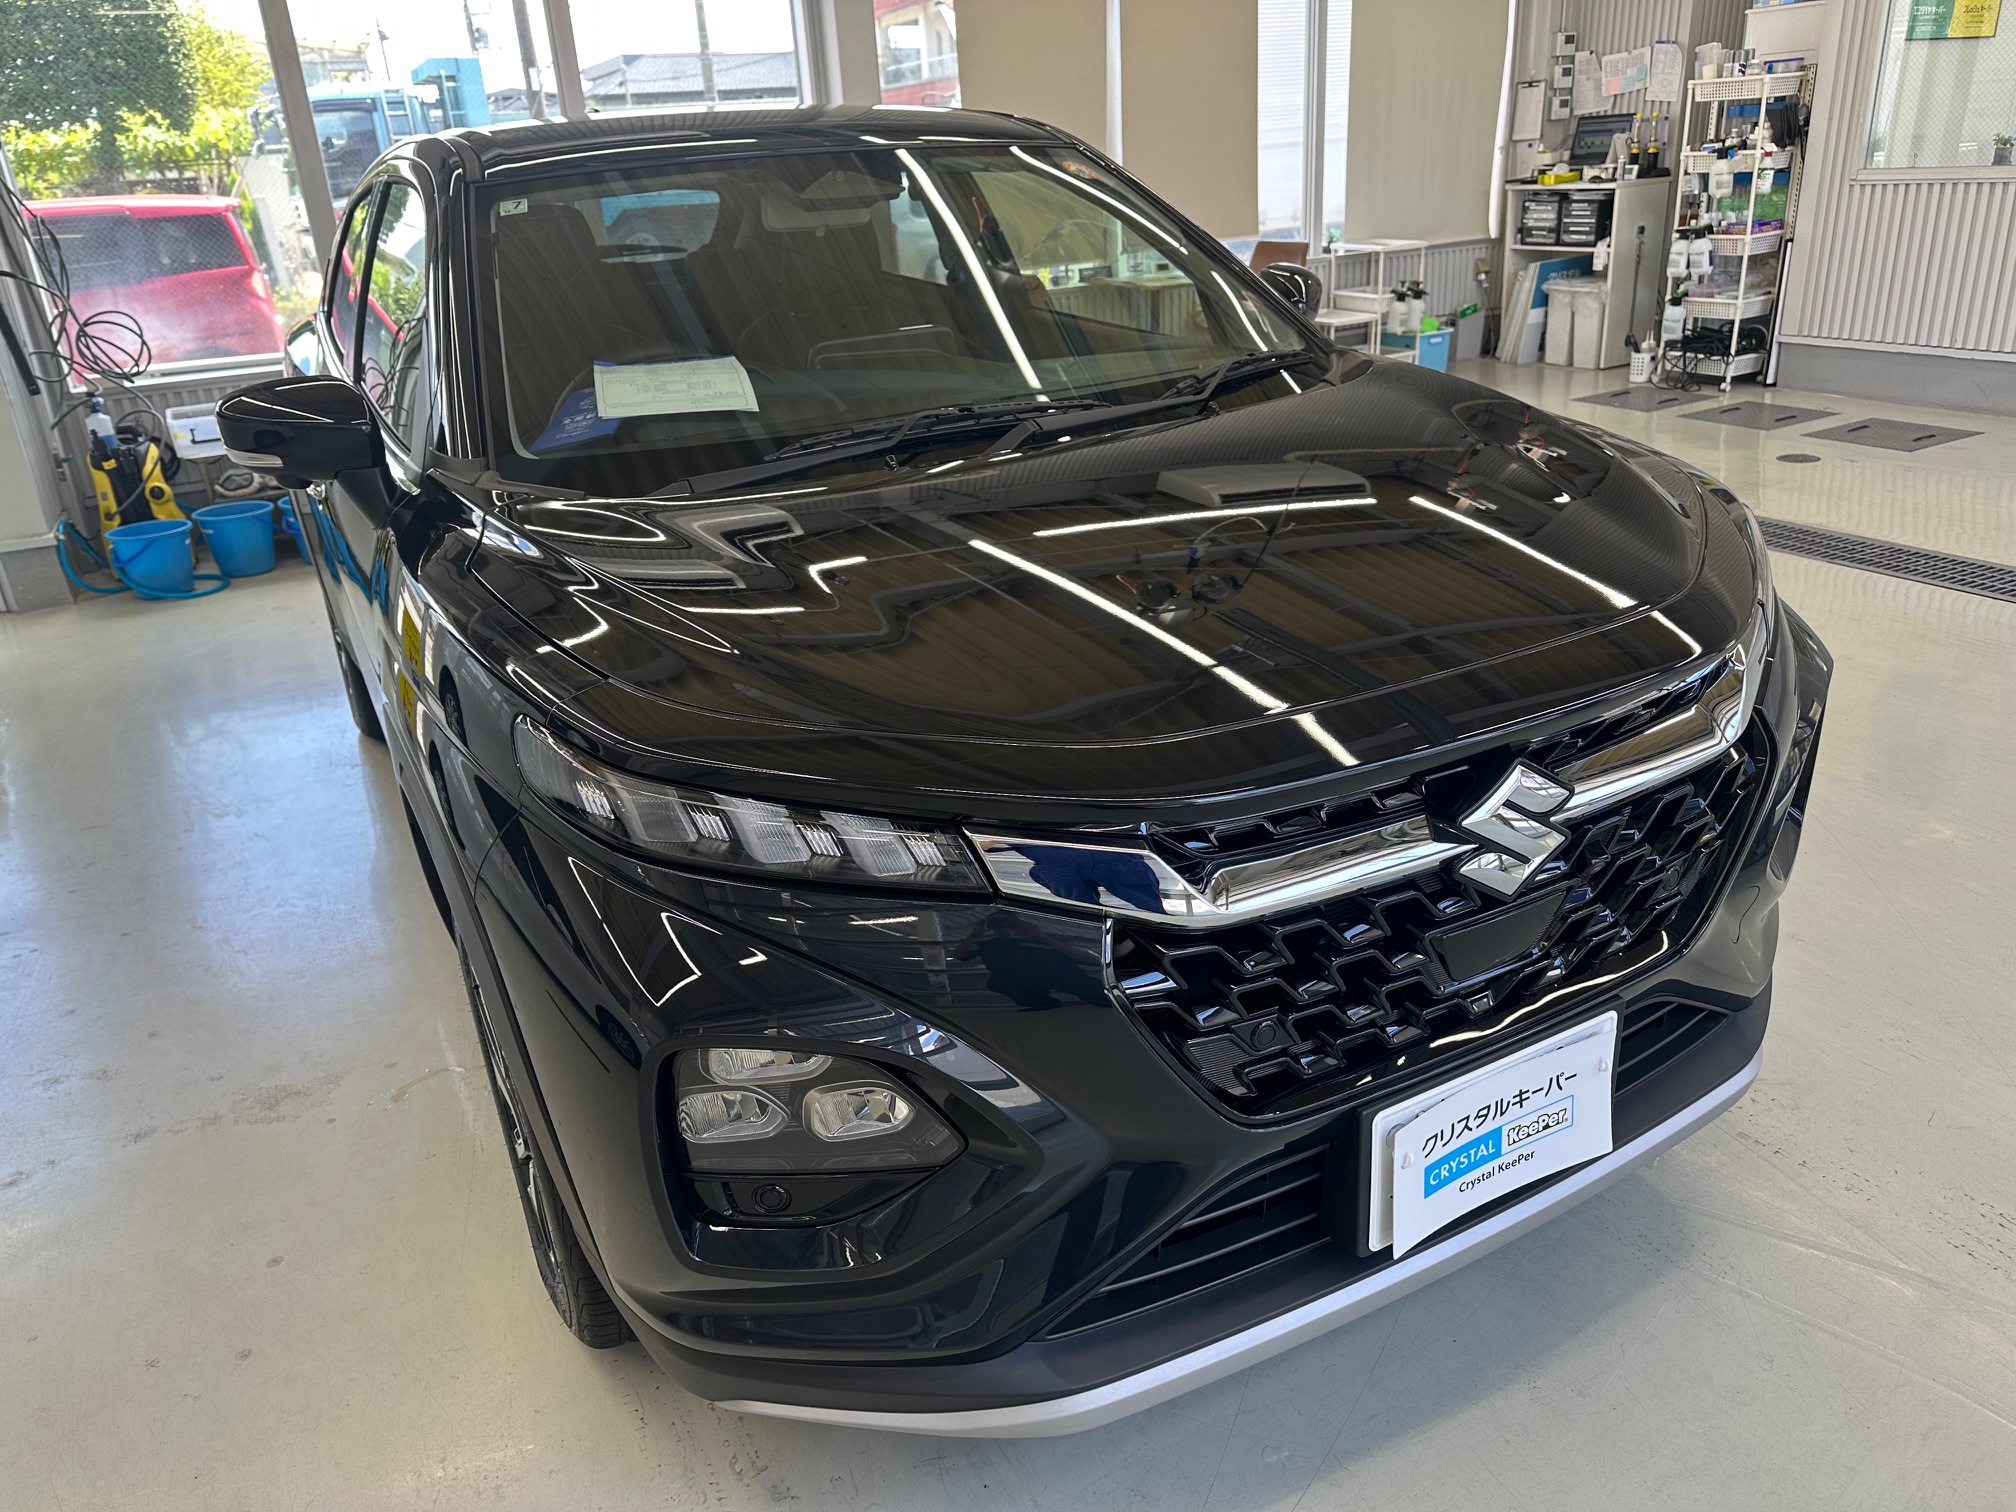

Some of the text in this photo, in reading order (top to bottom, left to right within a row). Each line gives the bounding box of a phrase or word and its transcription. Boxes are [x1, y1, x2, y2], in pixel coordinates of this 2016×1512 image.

[512, 201, 521, 209] 7
[1422, 1071, 1578, 1158] クリスタルキーパー
[1429, 1139, 1496, 1185] CRYSTAL
[1459, 1150, 1536, 1193] Crystal KeePer
